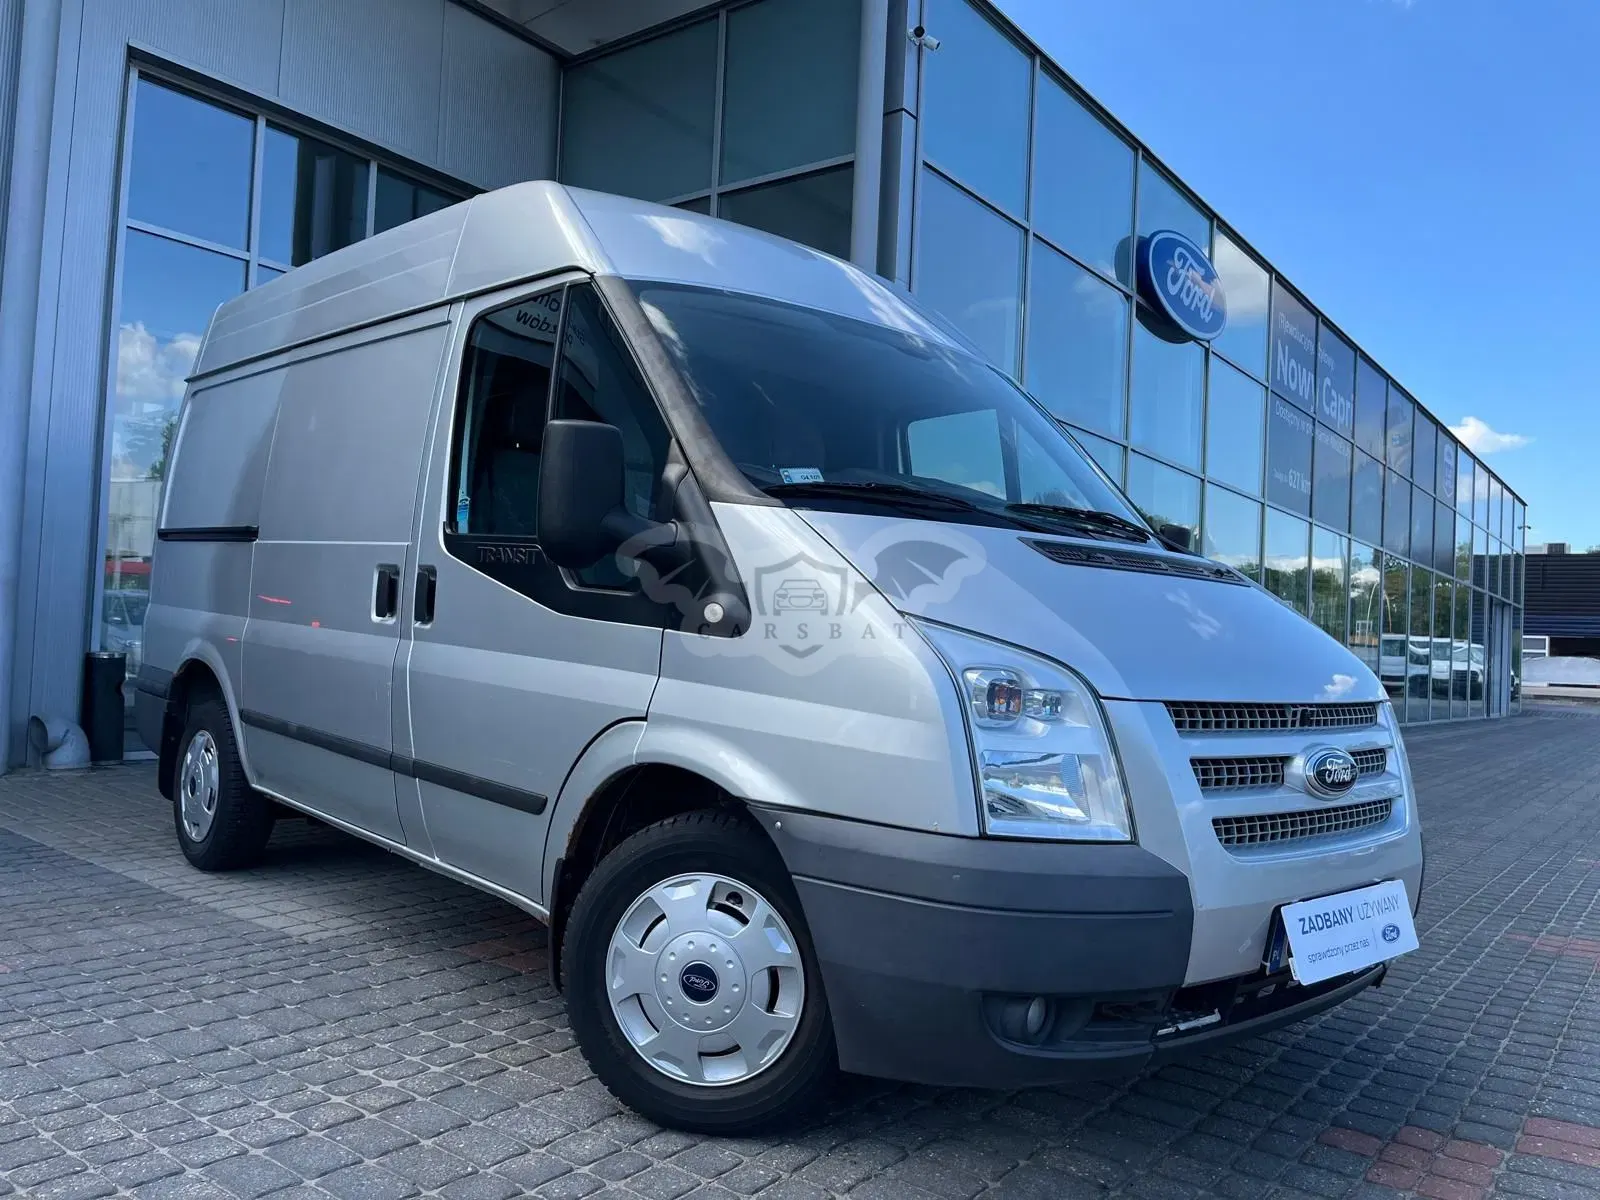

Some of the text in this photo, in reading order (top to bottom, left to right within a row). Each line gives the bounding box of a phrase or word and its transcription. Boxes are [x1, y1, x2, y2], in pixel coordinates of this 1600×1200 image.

[1166, 246, 1216, 324] Ford
[477, 546, 539, 565] TRANSIT
[1321, 758, 1351, 784] Ford
[1299, 894, 1400, 935] ZADBANY UŻYWANY
[1307, 937, 1370, 965] sprawdzony przez nas
[688, 976, 710, 989] Ford
